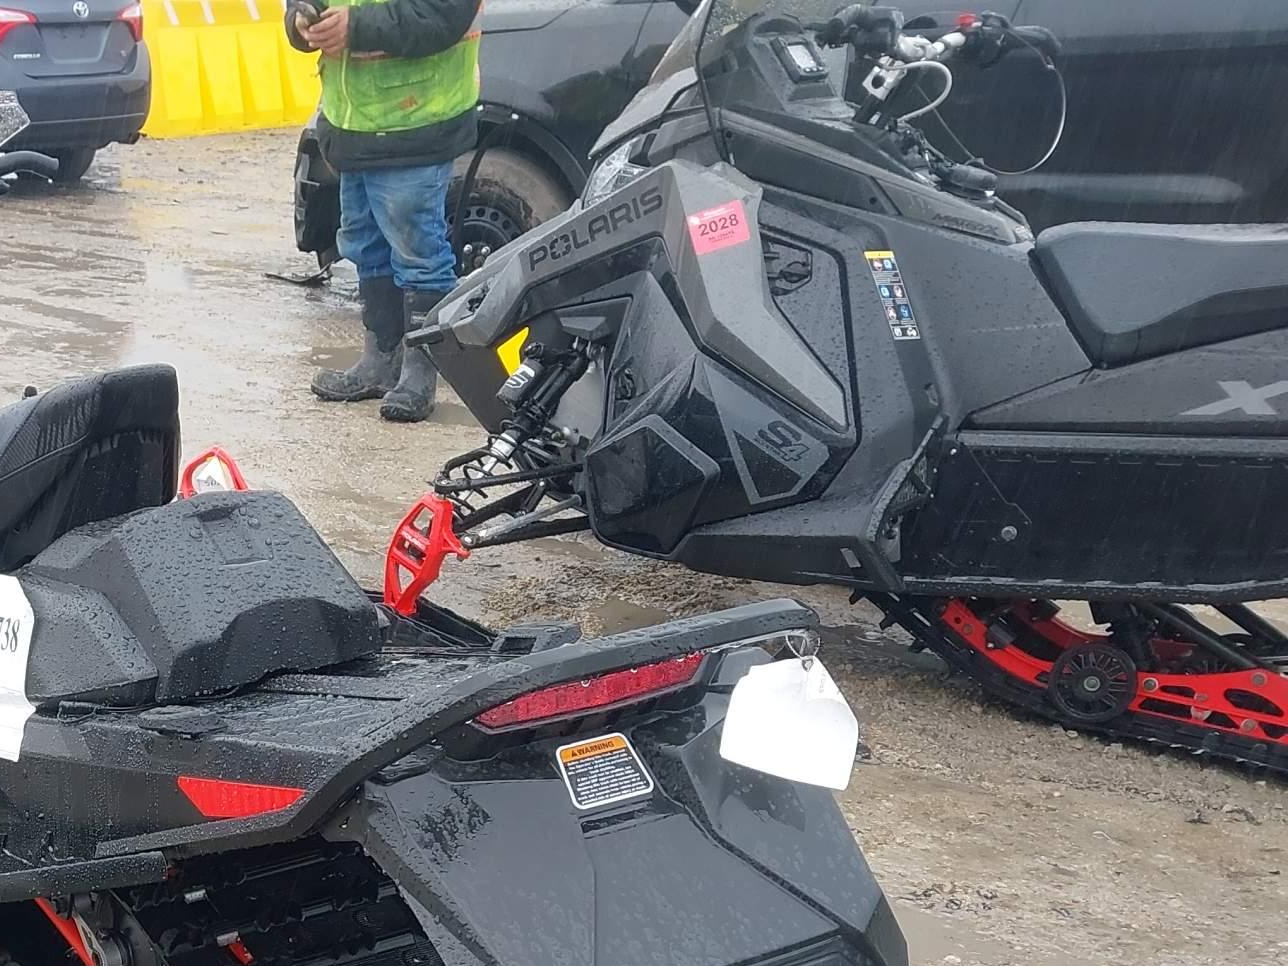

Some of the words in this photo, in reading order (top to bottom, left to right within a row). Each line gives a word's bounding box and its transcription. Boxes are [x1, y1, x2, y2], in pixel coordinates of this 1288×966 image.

[529, 186, 663, 272] POLARIS
[698, 214, 739, 237] 2028
[576, 741, 615, 755] WARNING
